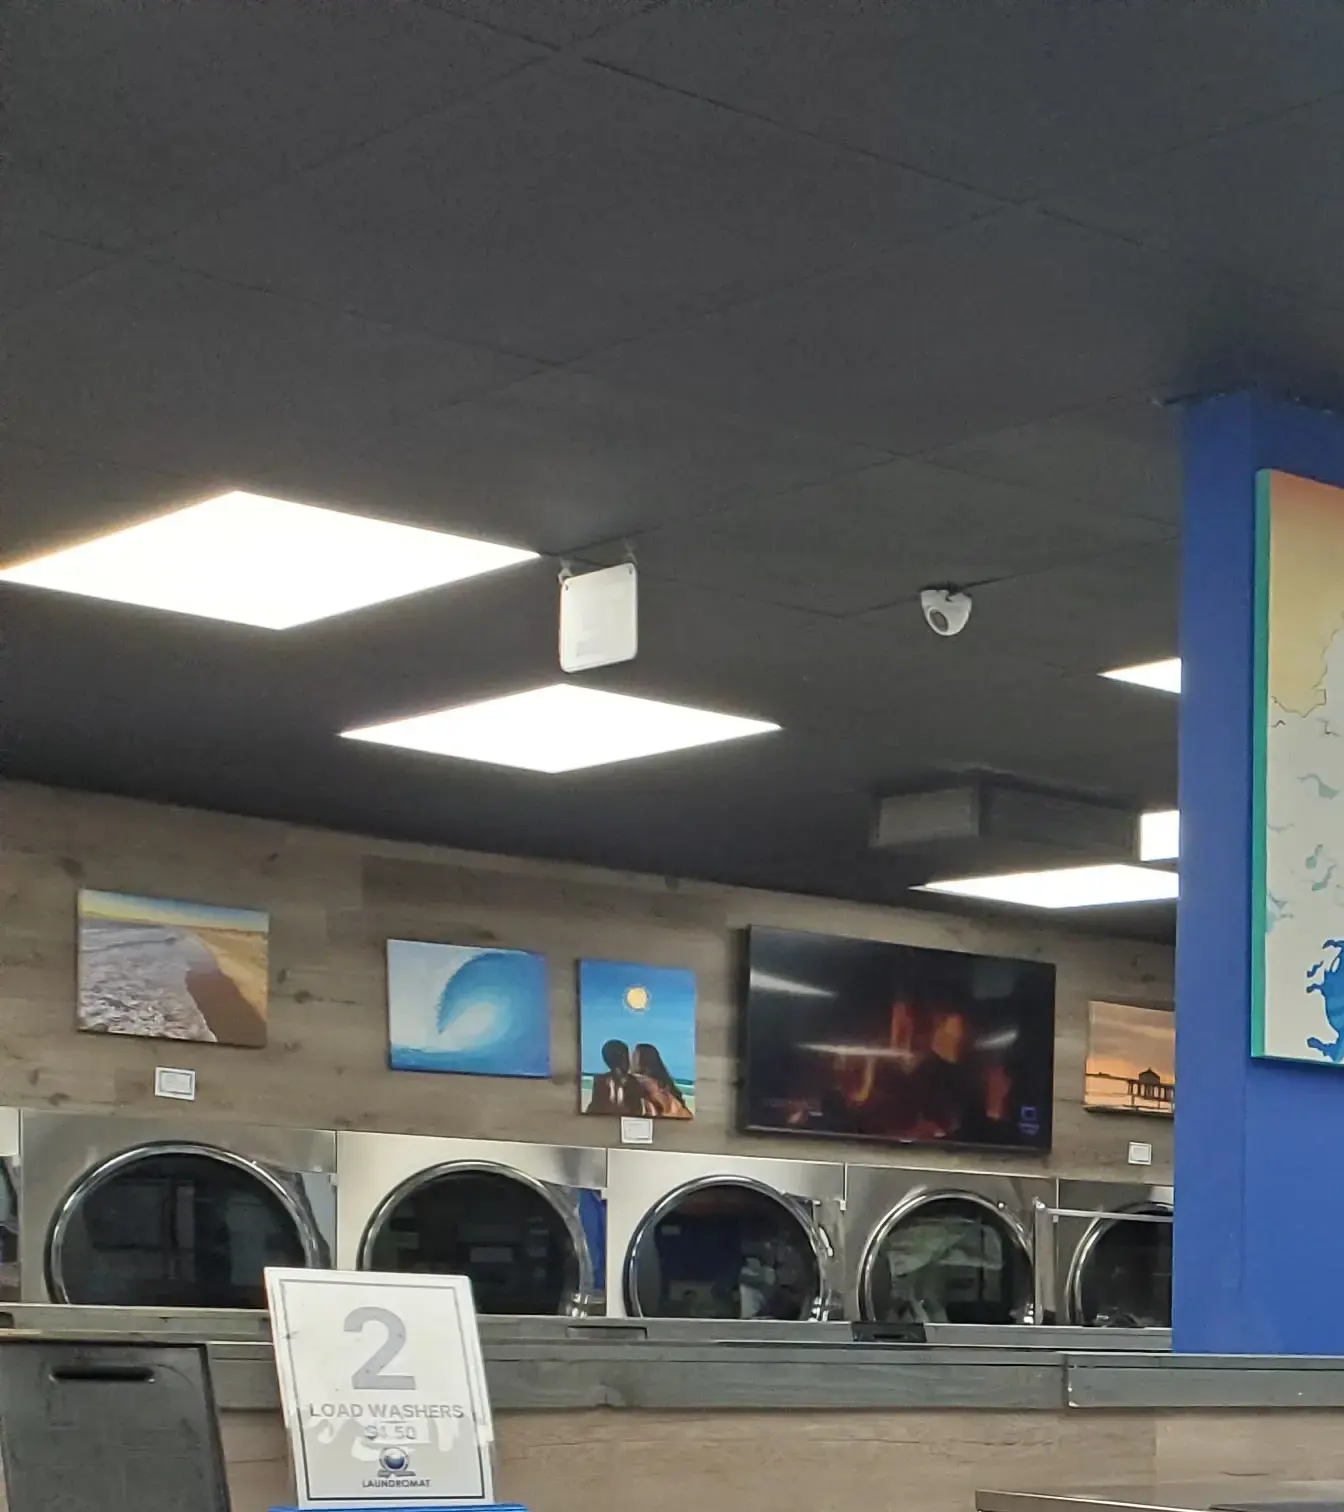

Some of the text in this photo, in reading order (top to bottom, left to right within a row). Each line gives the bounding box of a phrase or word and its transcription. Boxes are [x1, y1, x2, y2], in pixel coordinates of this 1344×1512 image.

[343, 1306, 417, 1391] 2
[309, 1403, 465, 1419] LOAD WASHERS
[362, 1479, 431, 1488] LAUNDROMAT
